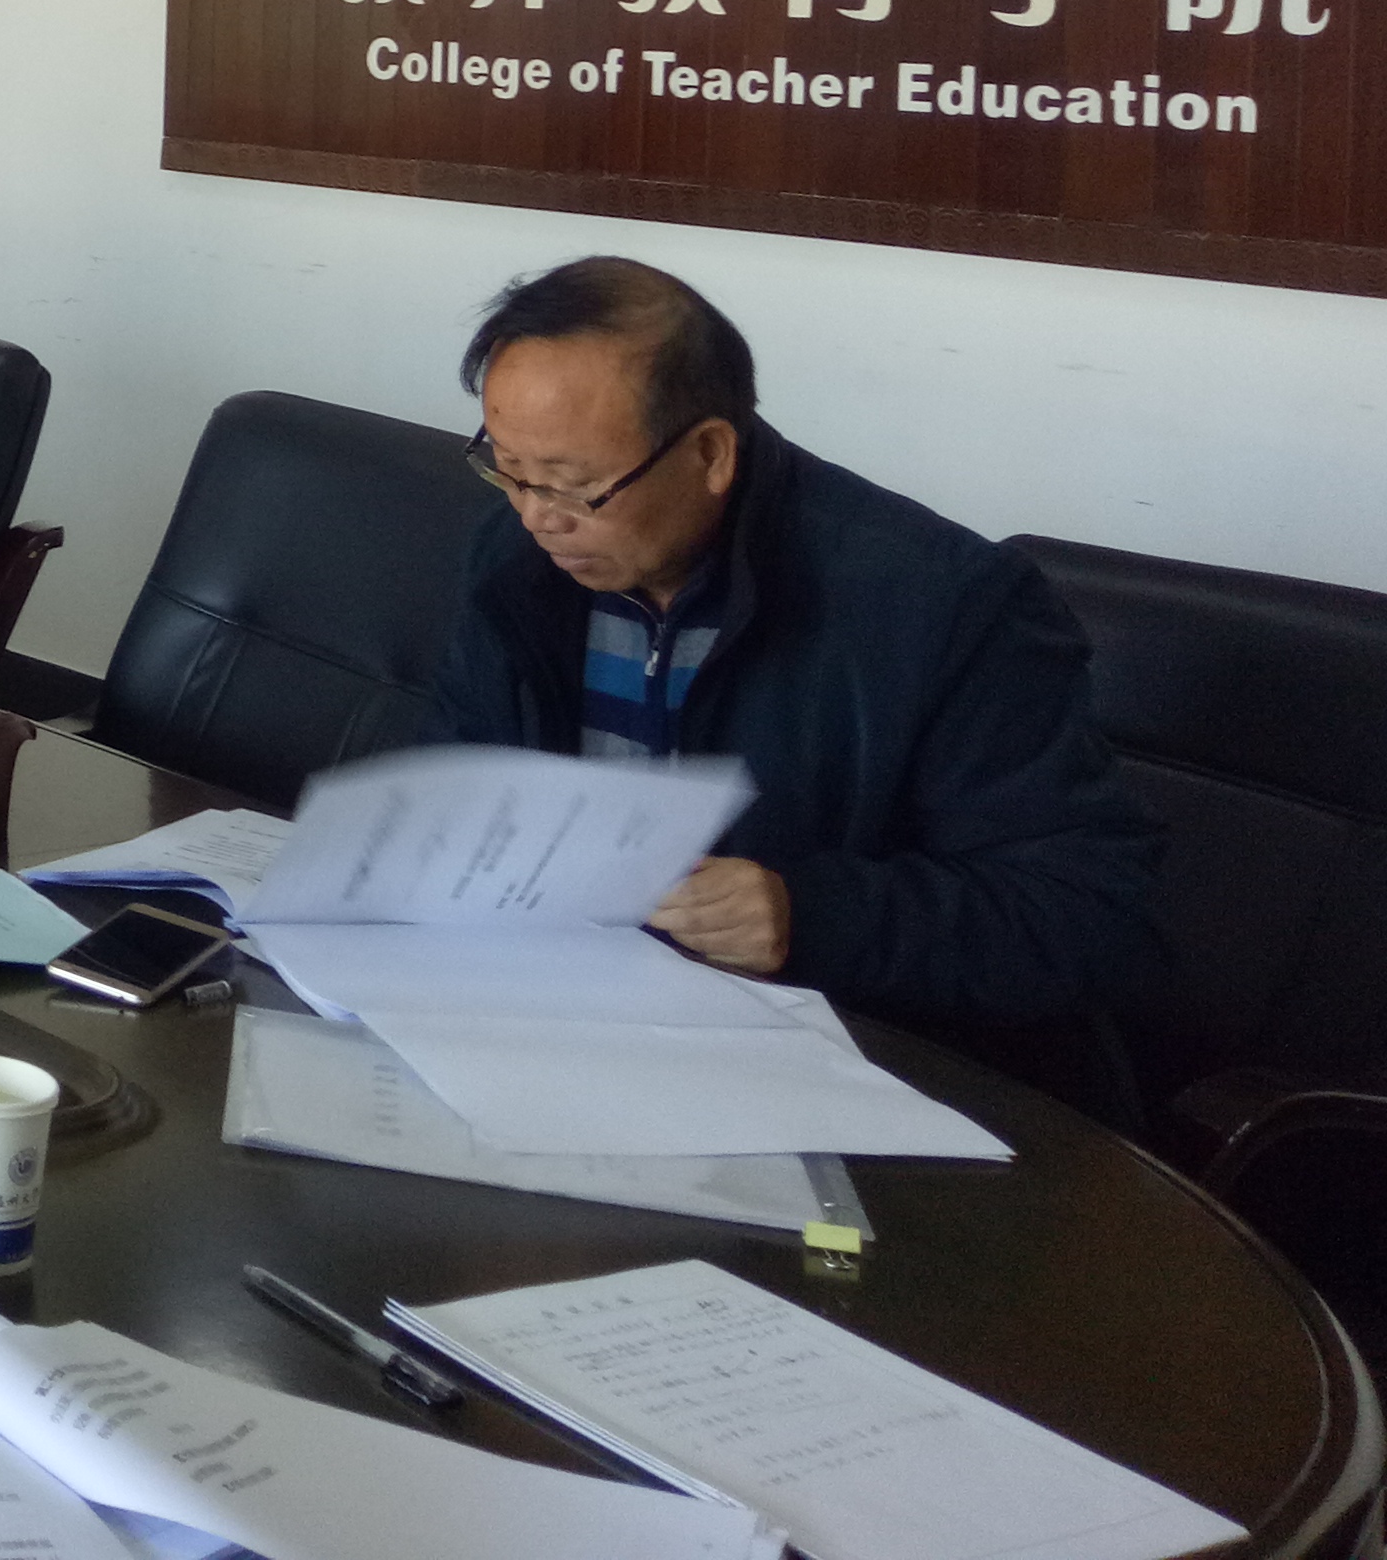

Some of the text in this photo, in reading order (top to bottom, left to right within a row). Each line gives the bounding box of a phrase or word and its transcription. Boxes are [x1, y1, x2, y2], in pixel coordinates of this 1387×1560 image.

[365, 37, 1259, 134] College of Teacher Education
